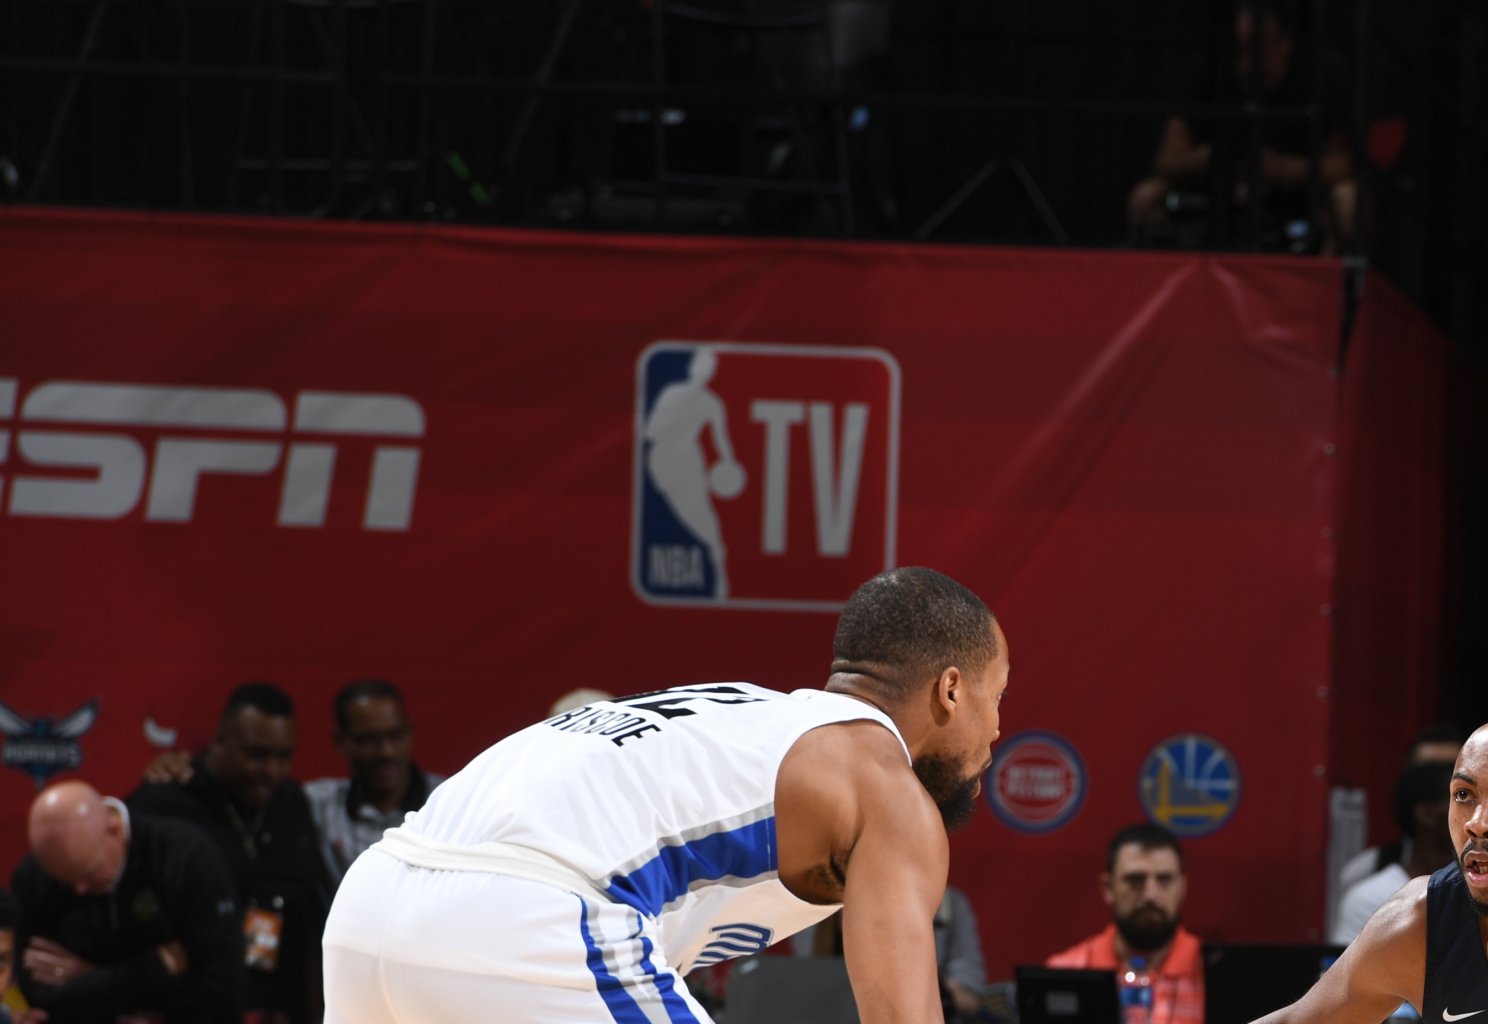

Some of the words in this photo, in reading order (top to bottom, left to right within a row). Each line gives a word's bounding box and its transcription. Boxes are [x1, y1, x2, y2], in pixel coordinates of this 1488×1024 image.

[0, 378, 425, 532] SPN
[752, 401, 869, 556] TV
[650, 546, 704, 587] NBA
